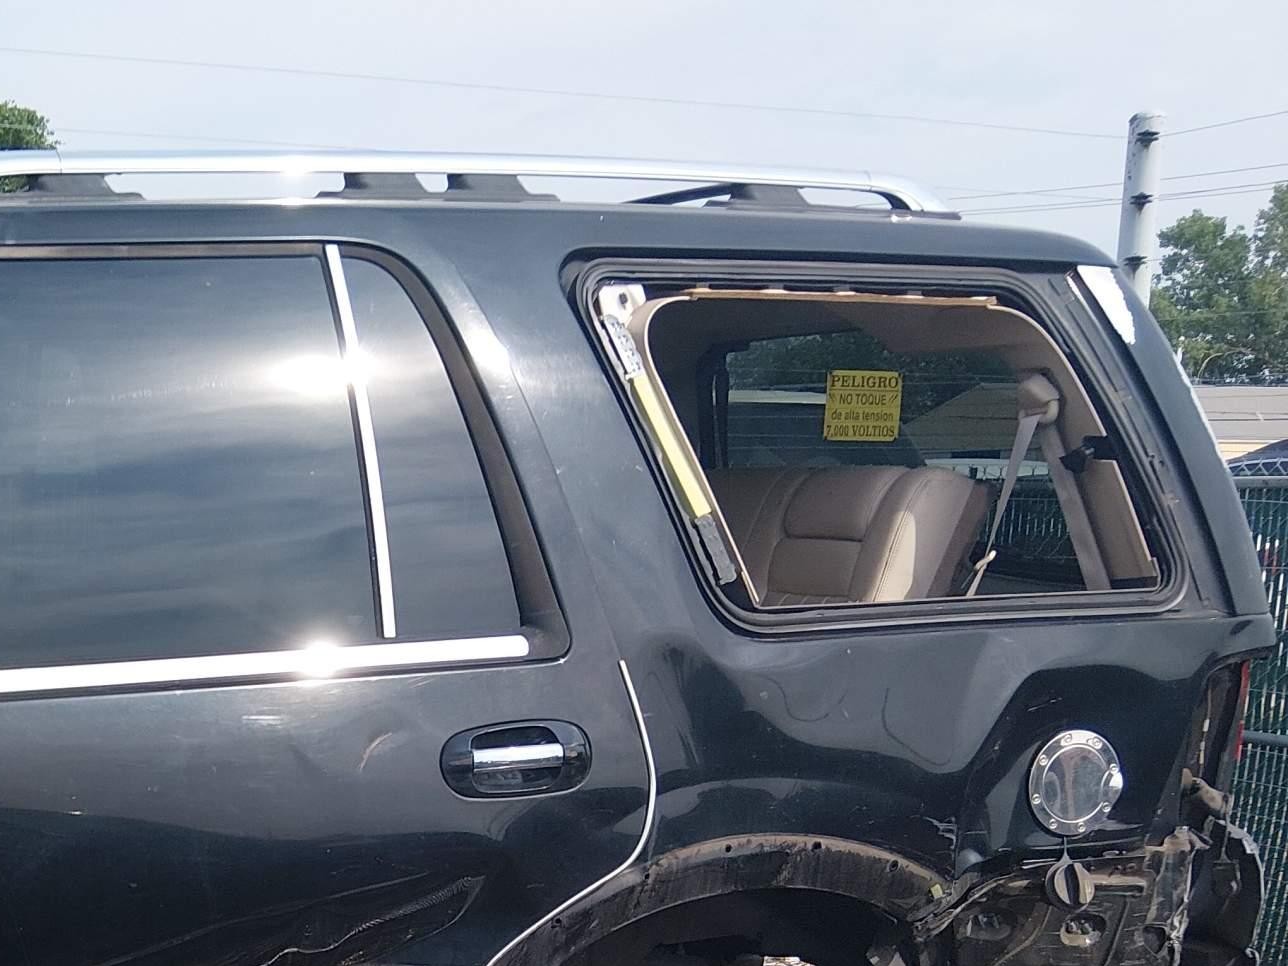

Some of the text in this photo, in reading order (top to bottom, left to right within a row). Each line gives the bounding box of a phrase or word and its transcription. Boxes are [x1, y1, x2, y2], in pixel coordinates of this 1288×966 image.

[831, 375, 899, 389] PELIGRO
[839, 394, 887, 405] NO TOQUE
[831, 409, 894, 421] de alta tension
[852, 425, 895, 437] VOLTIOS
